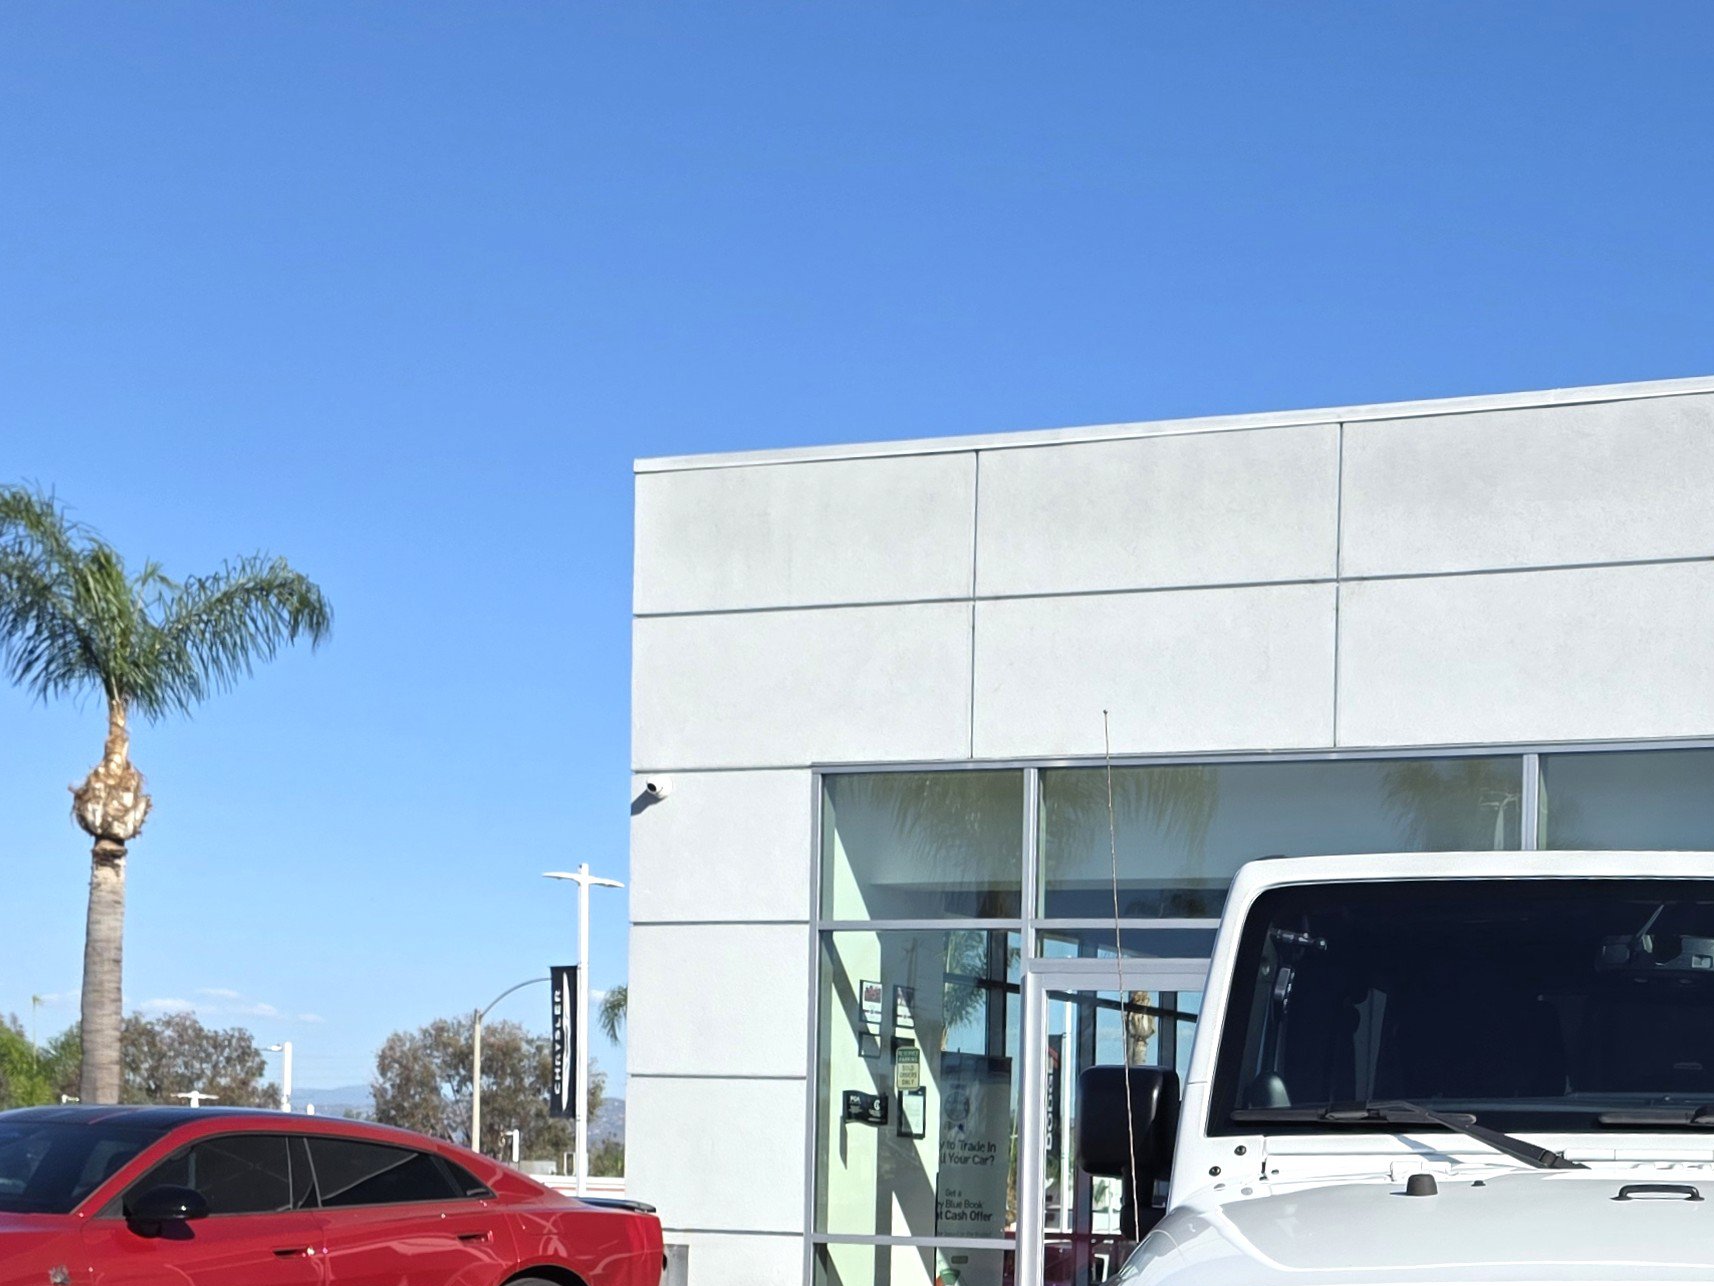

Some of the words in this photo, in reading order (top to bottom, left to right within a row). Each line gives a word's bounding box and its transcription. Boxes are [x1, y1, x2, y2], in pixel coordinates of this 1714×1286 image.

[946, 1140, 956, 1150] to
[959, 1140, 986, 1152] Trade
[987, 1142, 997, 1153] In
[949, 1153, 971, 1165] Your
[972, 1154, 995, 1166] Car?
[945, 1199, 962, 1209] Blue
[964, 1200, 982, 1209] Book
[945, 1210, 967, 1220] Cash
[969, 1211, 993, 1222] Offer
